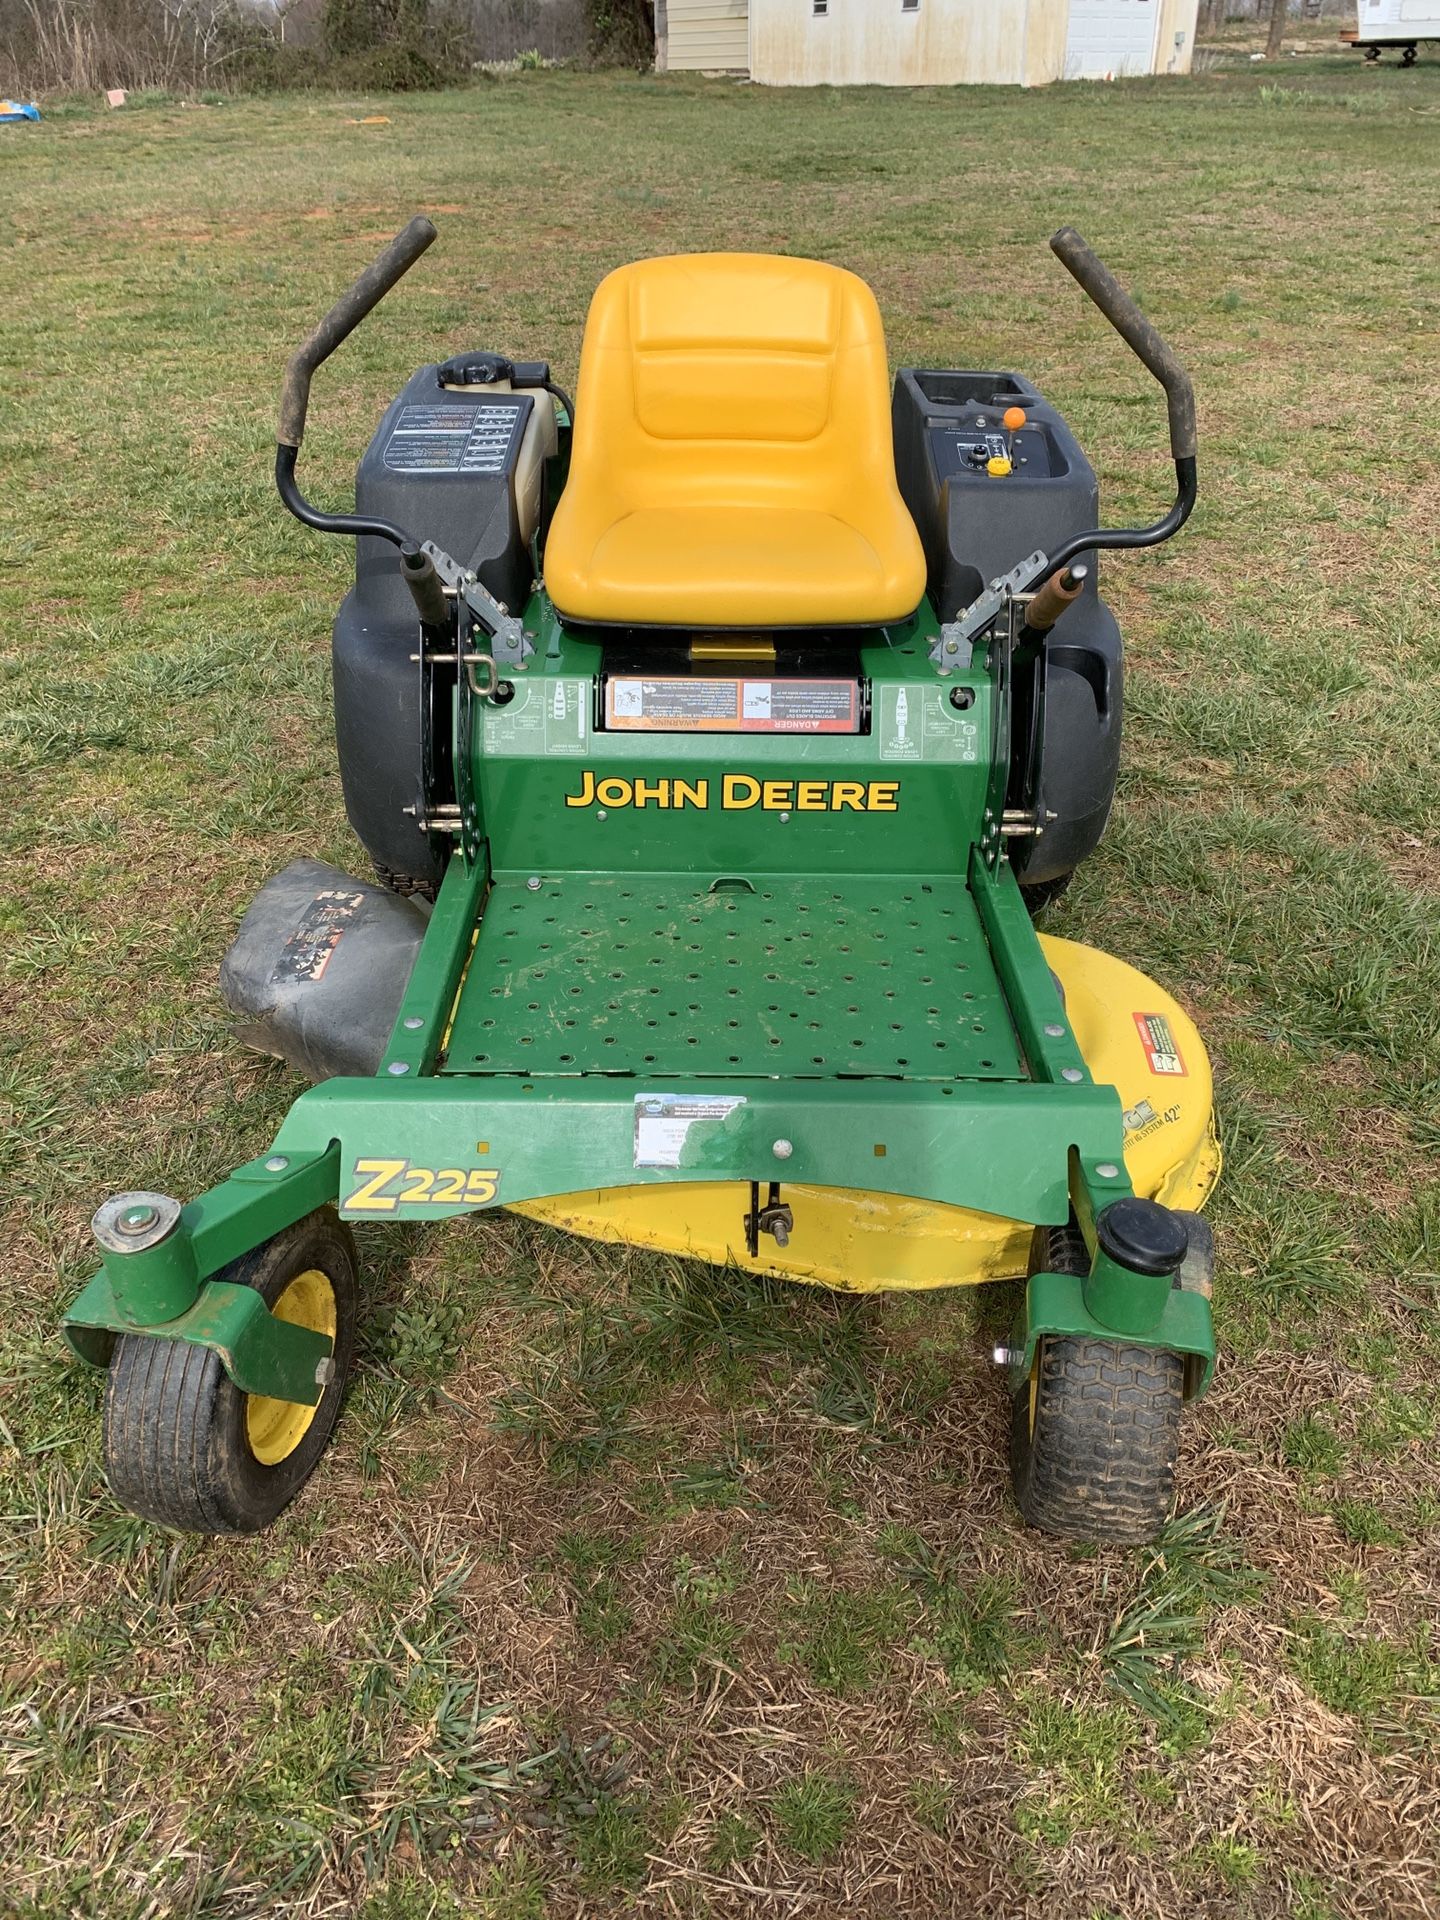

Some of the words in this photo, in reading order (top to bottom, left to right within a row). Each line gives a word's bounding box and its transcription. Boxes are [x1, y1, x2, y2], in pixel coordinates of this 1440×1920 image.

[774, 720, 812, 729] DANGER
[566, 771, 708, 809] JOHN
[721, 773, 900, 811] DEERE
[1142, 1119, 1165, 1139] SYSTEM
[1163, 1103, 1182, 1125] 42"
[340, 1157, 502, 1213] Z225
